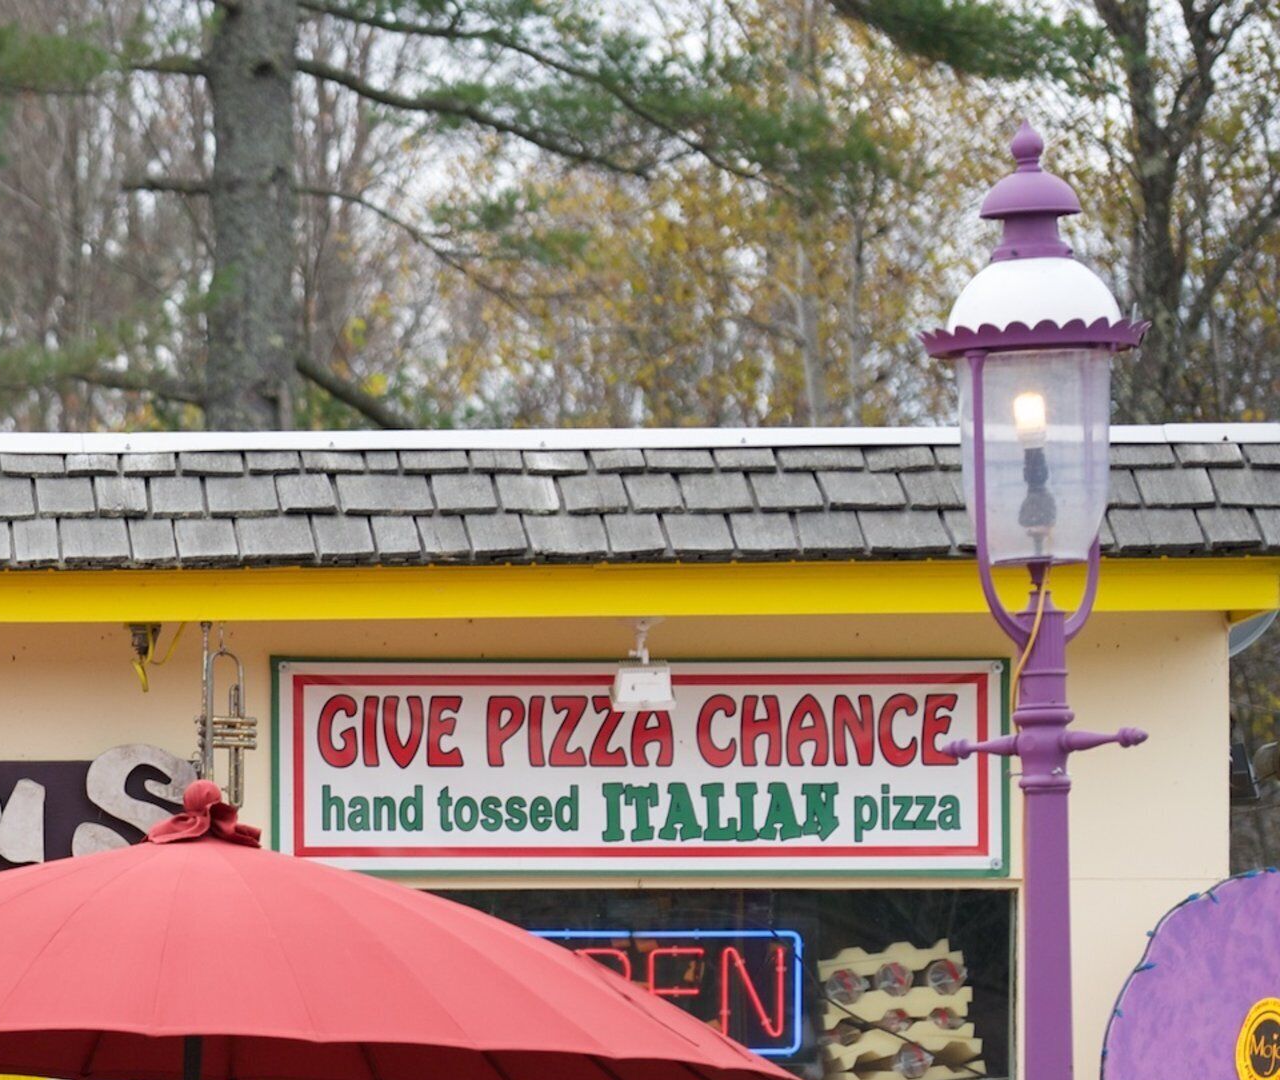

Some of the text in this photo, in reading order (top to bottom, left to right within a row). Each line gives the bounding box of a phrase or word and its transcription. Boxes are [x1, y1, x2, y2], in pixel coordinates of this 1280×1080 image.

[317, 693, 960, 769] GIVE PIZZA CHANCE
[321, 781, 962, 843] hand tossed ITALIAN pizza
